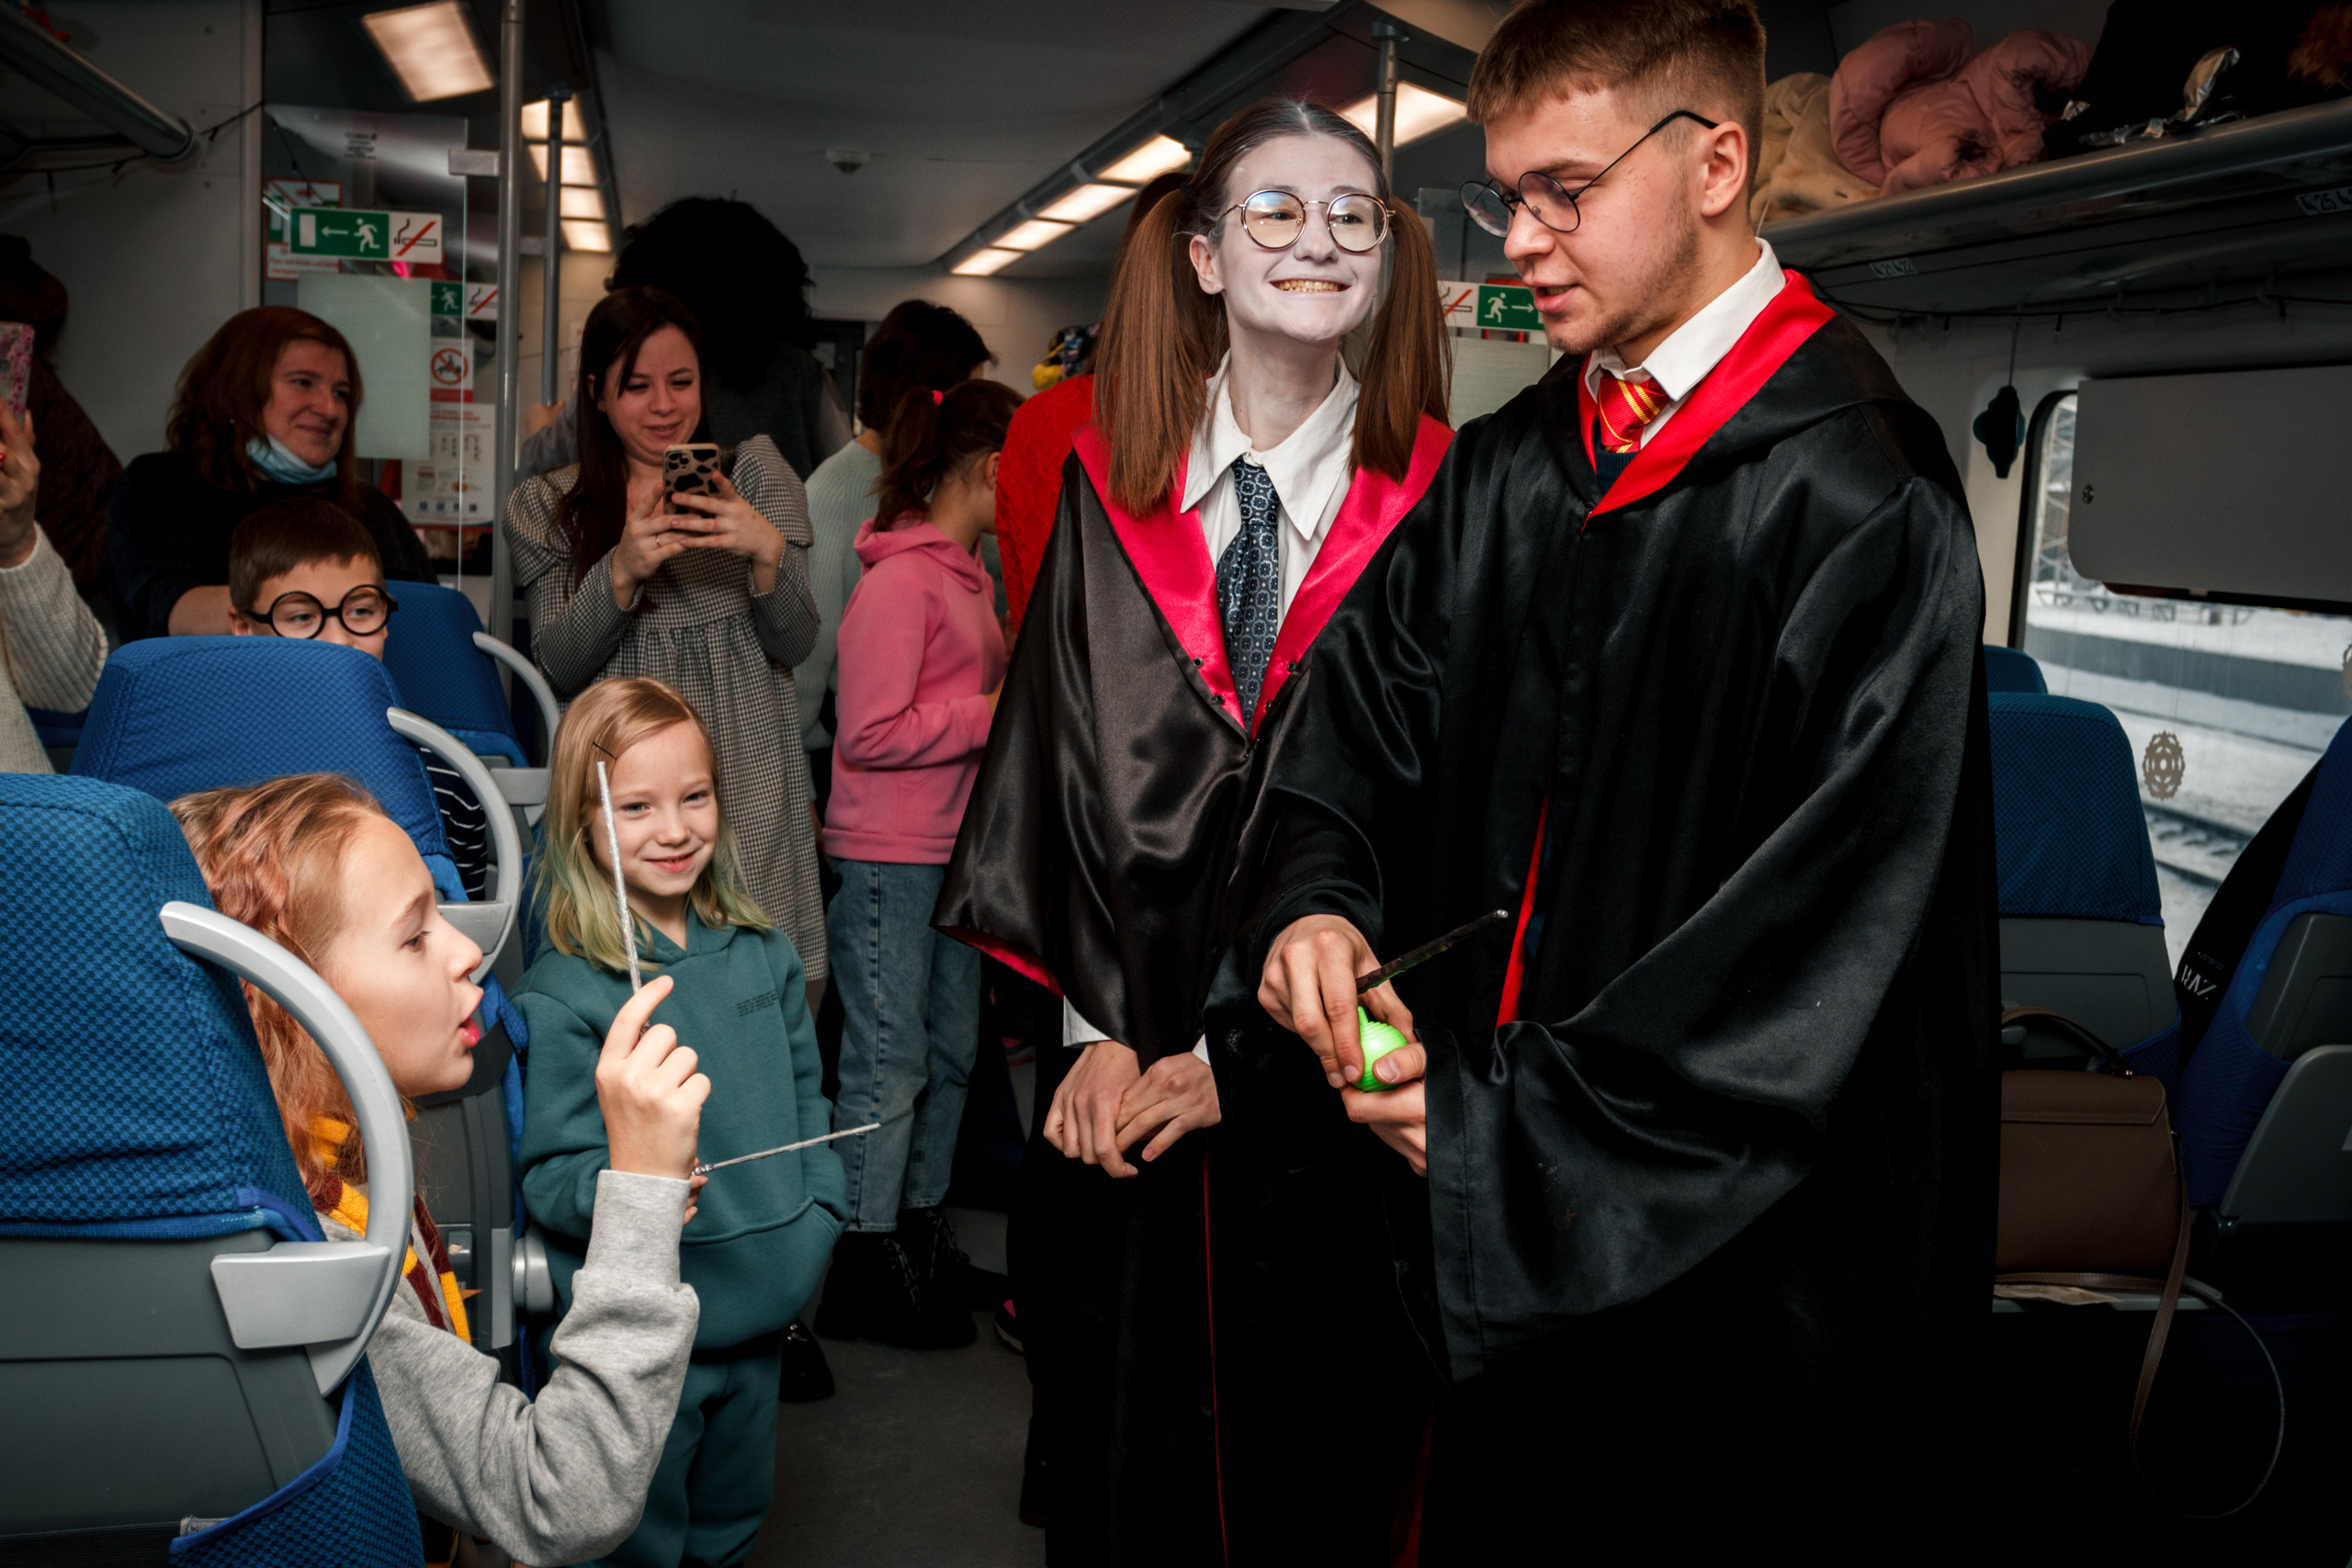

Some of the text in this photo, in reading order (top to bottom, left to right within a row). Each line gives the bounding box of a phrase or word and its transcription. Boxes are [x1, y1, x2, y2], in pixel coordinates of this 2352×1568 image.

[2313, 193, 2337, 211] 25
[1881, 260, 1915, 276] 21 22
